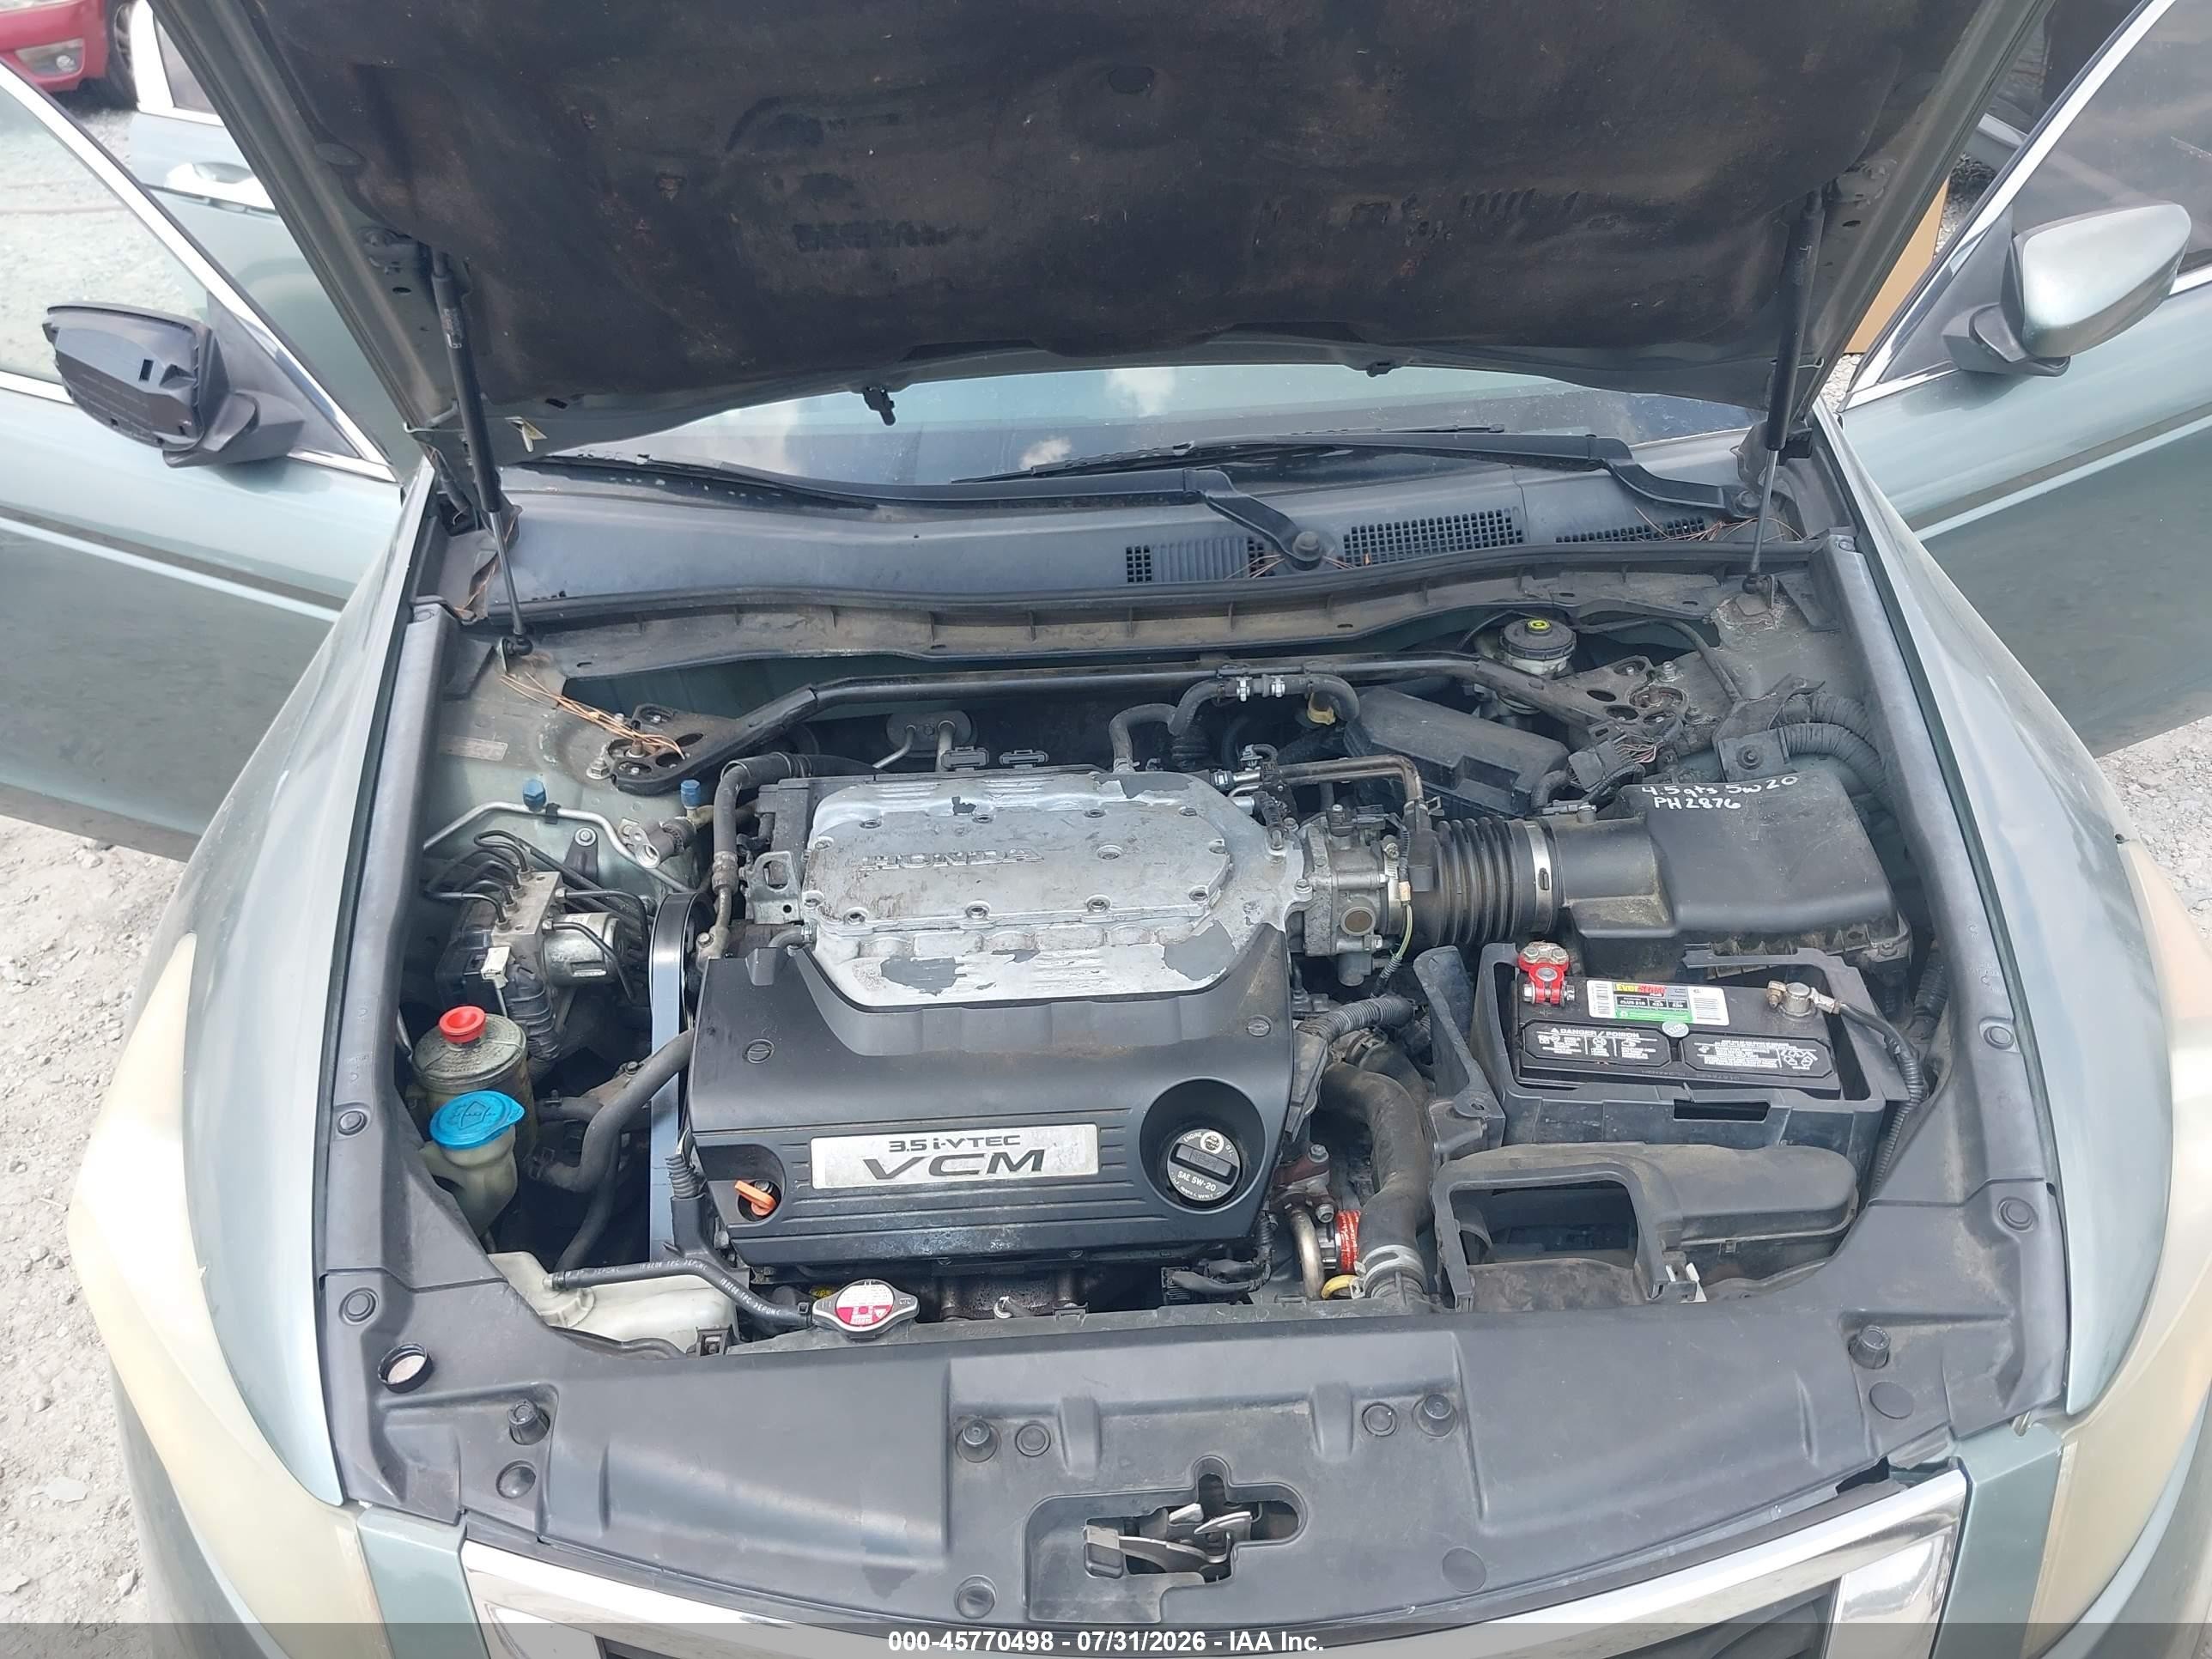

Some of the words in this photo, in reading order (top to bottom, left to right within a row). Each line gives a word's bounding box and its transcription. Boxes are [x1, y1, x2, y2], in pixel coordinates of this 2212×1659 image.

[1642, 785, 1680, 796] 4.5
[889, 1139, 927, 1152] 3.5
[863, 1149, 1045, 1180] VCM
[1177, 1170, 1190, 1182] SAE
